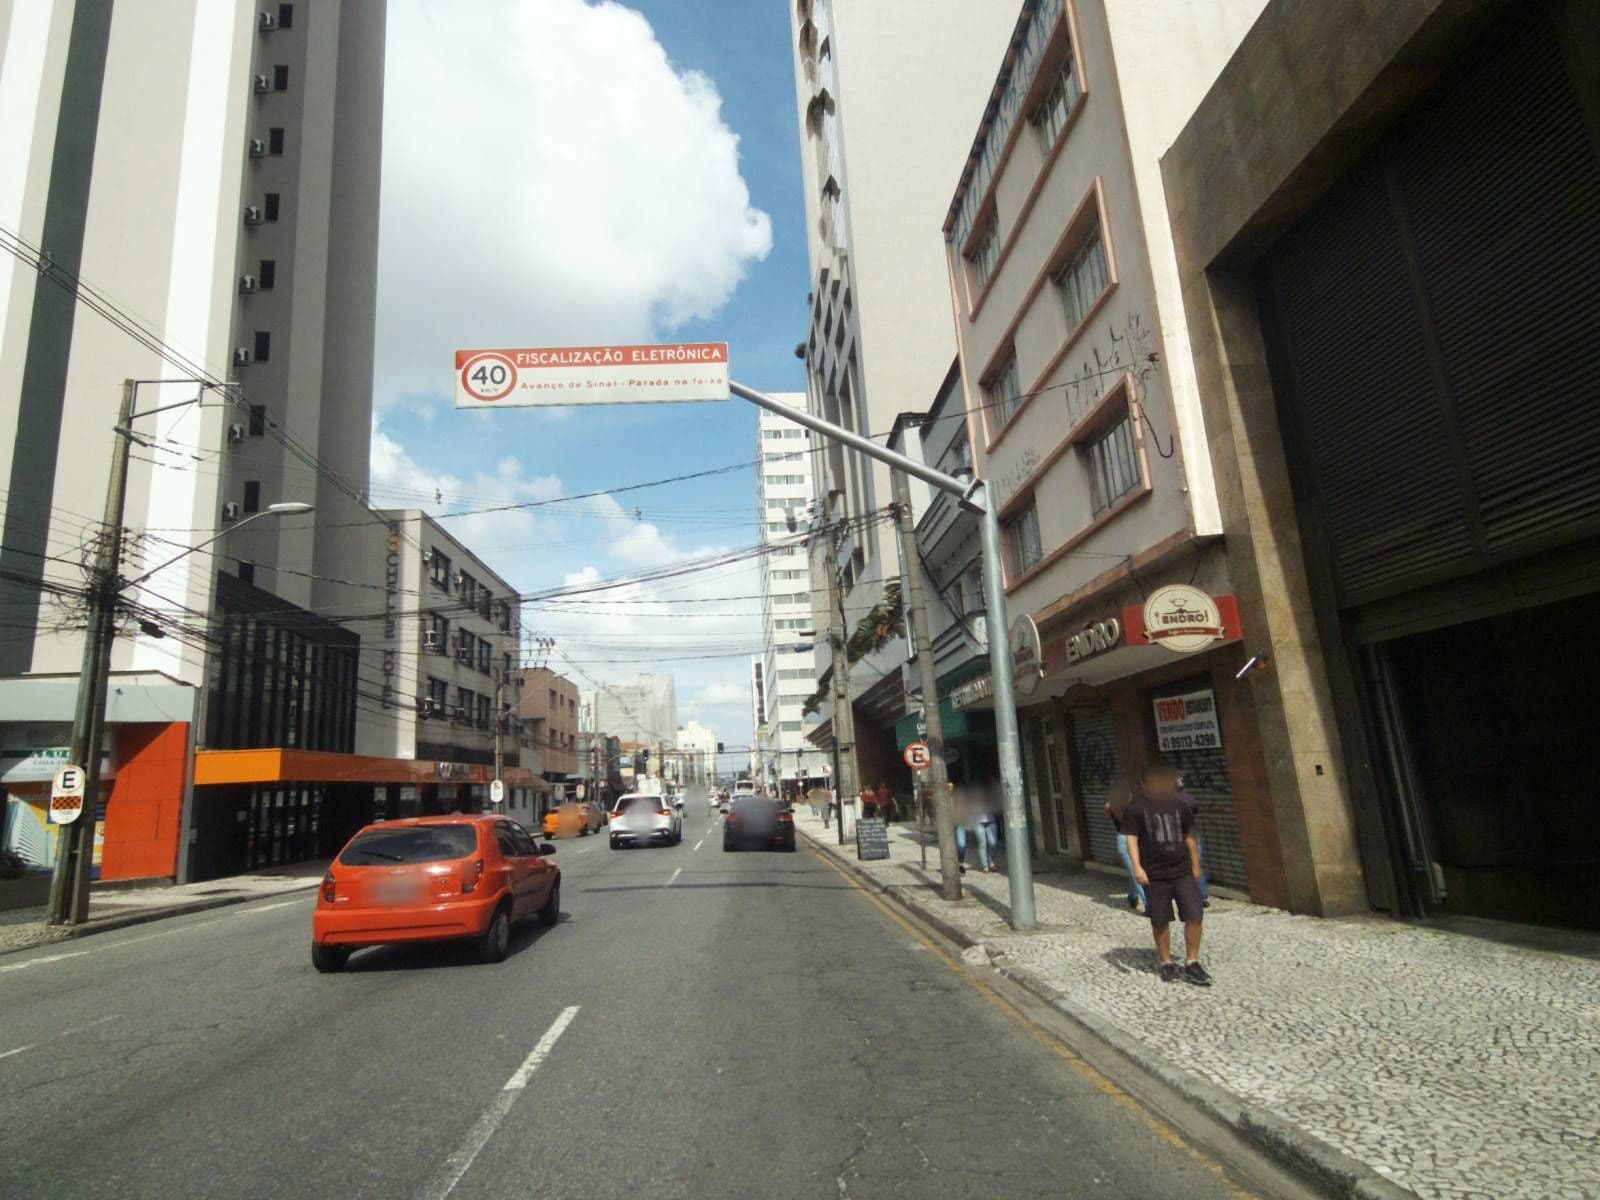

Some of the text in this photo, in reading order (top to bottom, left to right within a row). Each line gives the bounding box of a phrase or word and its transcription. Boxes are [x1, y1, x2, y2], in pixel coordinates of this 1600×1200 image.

[516, 346, 722, 366] FISCALIZAÇÃO ELETRÔNICA
[471, 365, 506, 385] 40
[520, 381, 564, 390] Avanço
[568, 380, 582, 389] de
[586, 380, 617, 388] Sinal
[628, 378, 669, 387] Parada
[1162, 613, 1205, 625] ENDRO
[1065, 618, 1120, 663] ENDRO
[913, 747, 926, 763] E
[62, 771, 76, 789] E
